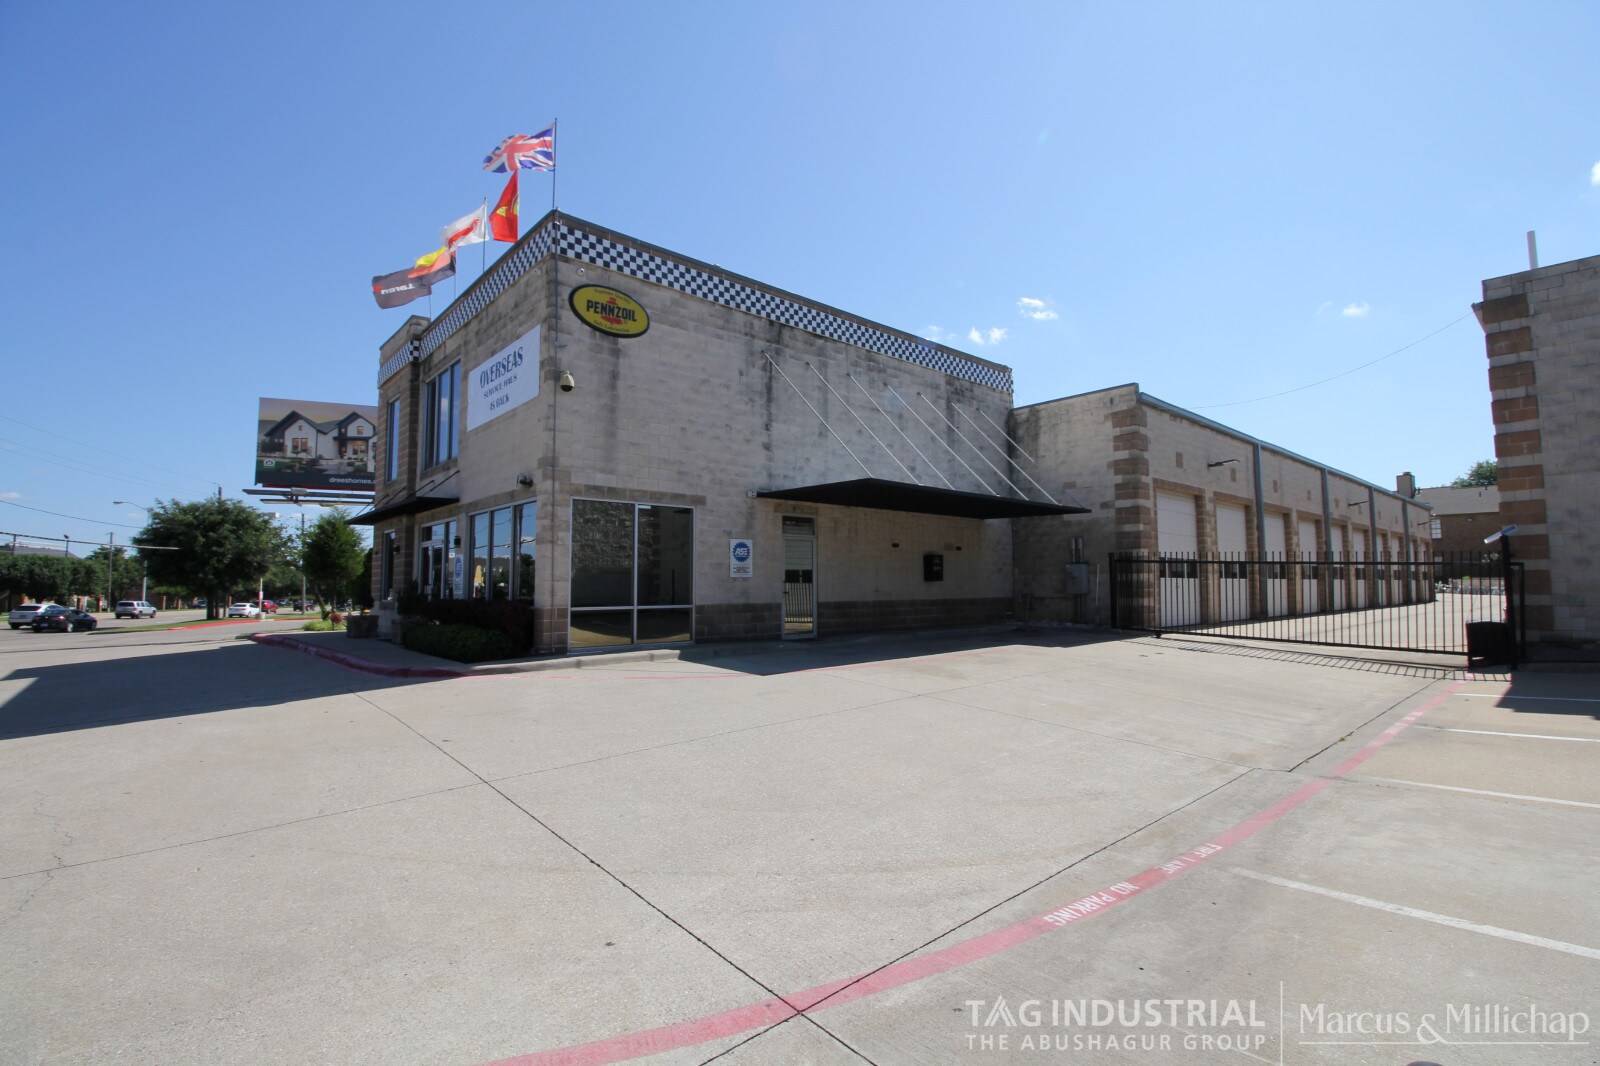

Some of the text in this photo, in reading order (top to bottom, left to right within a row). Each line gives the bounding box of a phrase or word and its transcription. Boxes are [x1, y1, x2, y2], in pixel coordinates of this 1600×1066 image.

[586, 299, 637, 322] PENNZOIL
[480, 346, 523, 388] OVERSEAS
[483, 382, 503, 399] SERVICE
[490, 393, 510, 411] IS BACK
[735, 547, 748, 556] ASE
[1042, 842, 1223, 926] FIRE LANE NO PARKING
